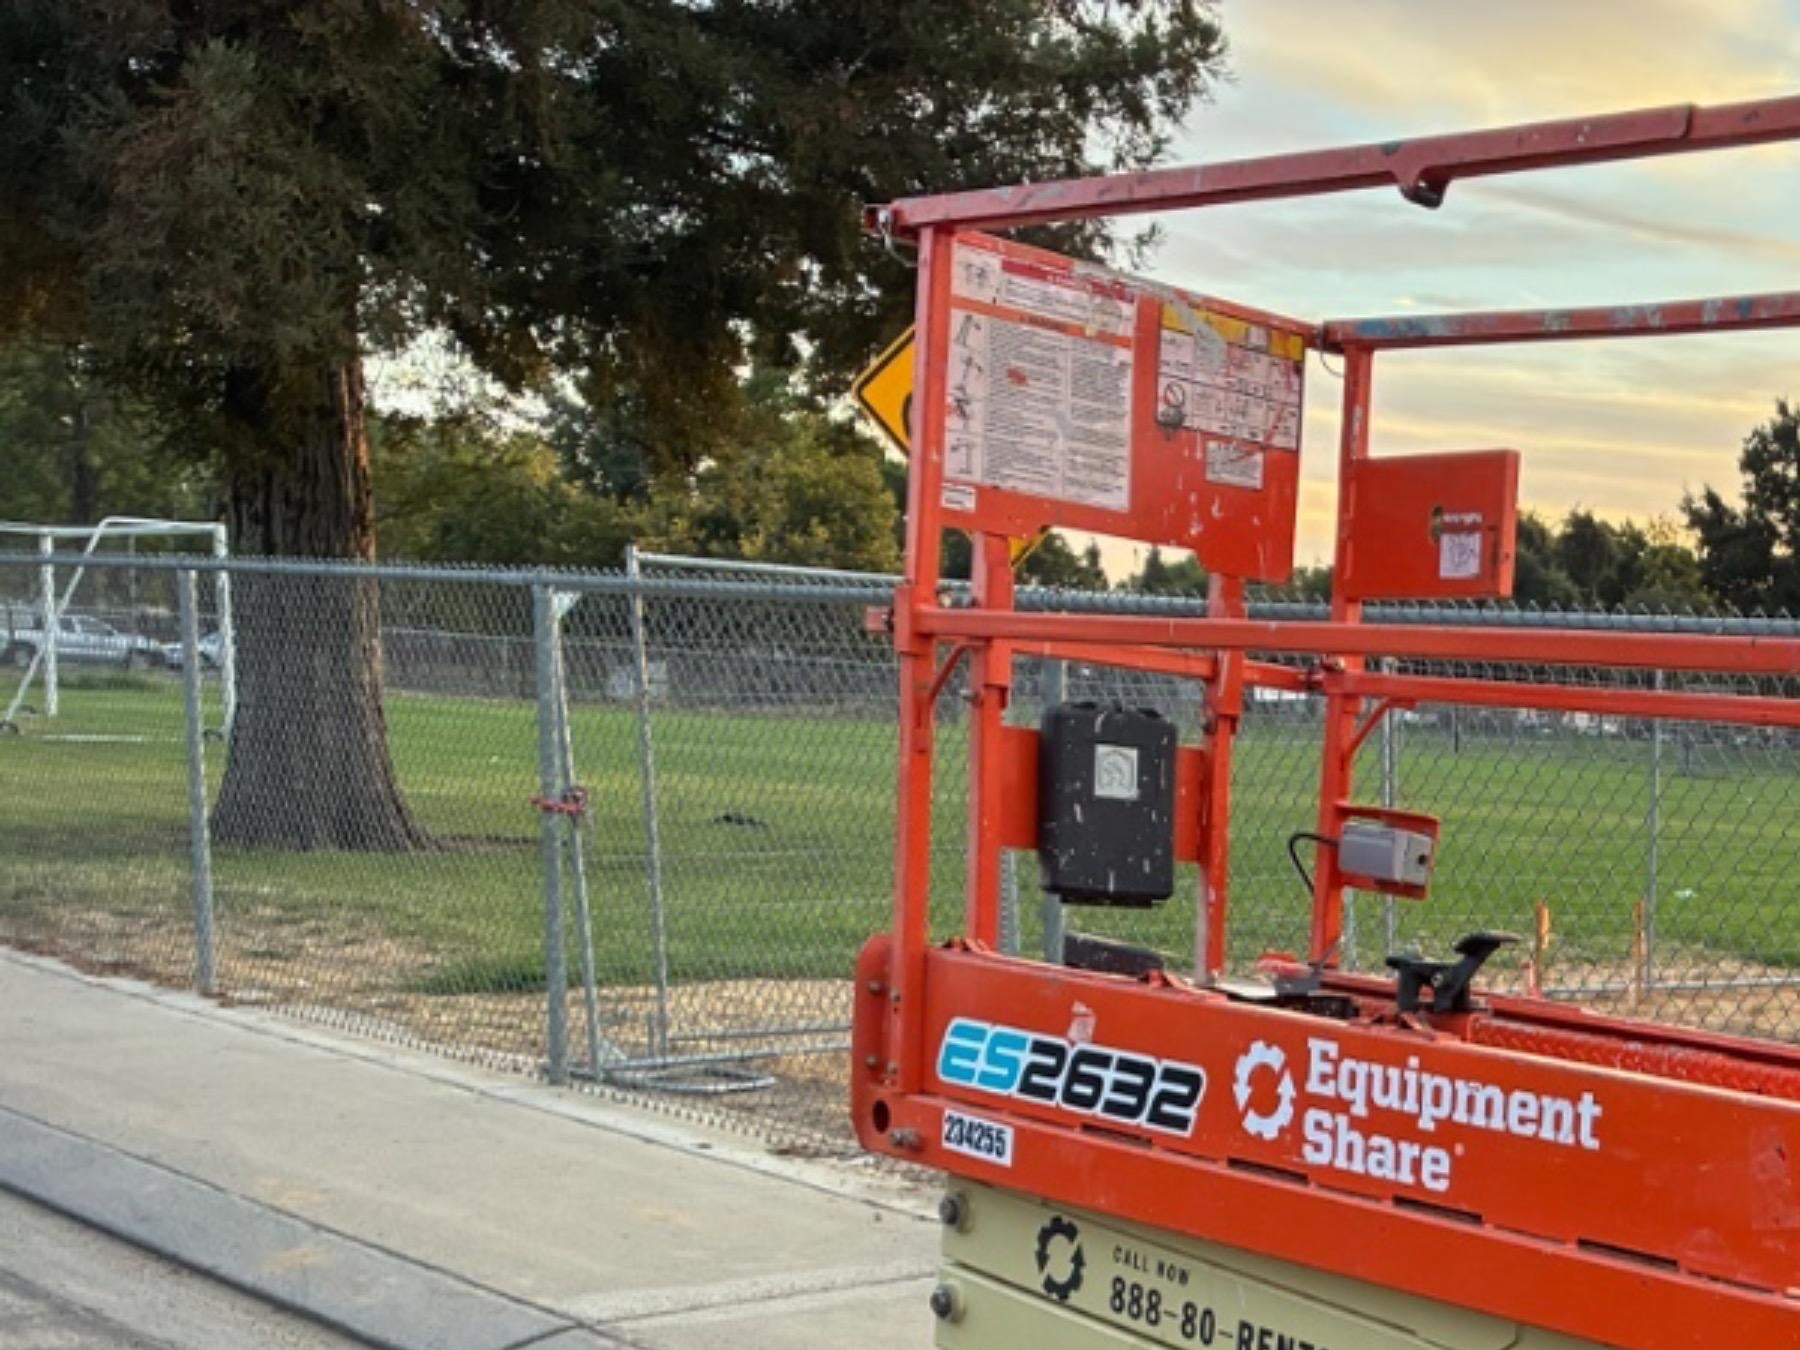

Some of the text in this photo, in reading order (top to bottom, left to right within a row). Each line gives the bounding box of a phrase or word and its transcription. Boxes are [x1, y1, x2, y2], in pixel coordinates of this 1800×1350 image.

[938, 1018, 1206, 1136] ES2632
[1305, 1037, 1603, 1150] Equipment
[943, 1114, 1007, 1158] 234255
[1112, 1244, 1191, 1286] CALL NOW
